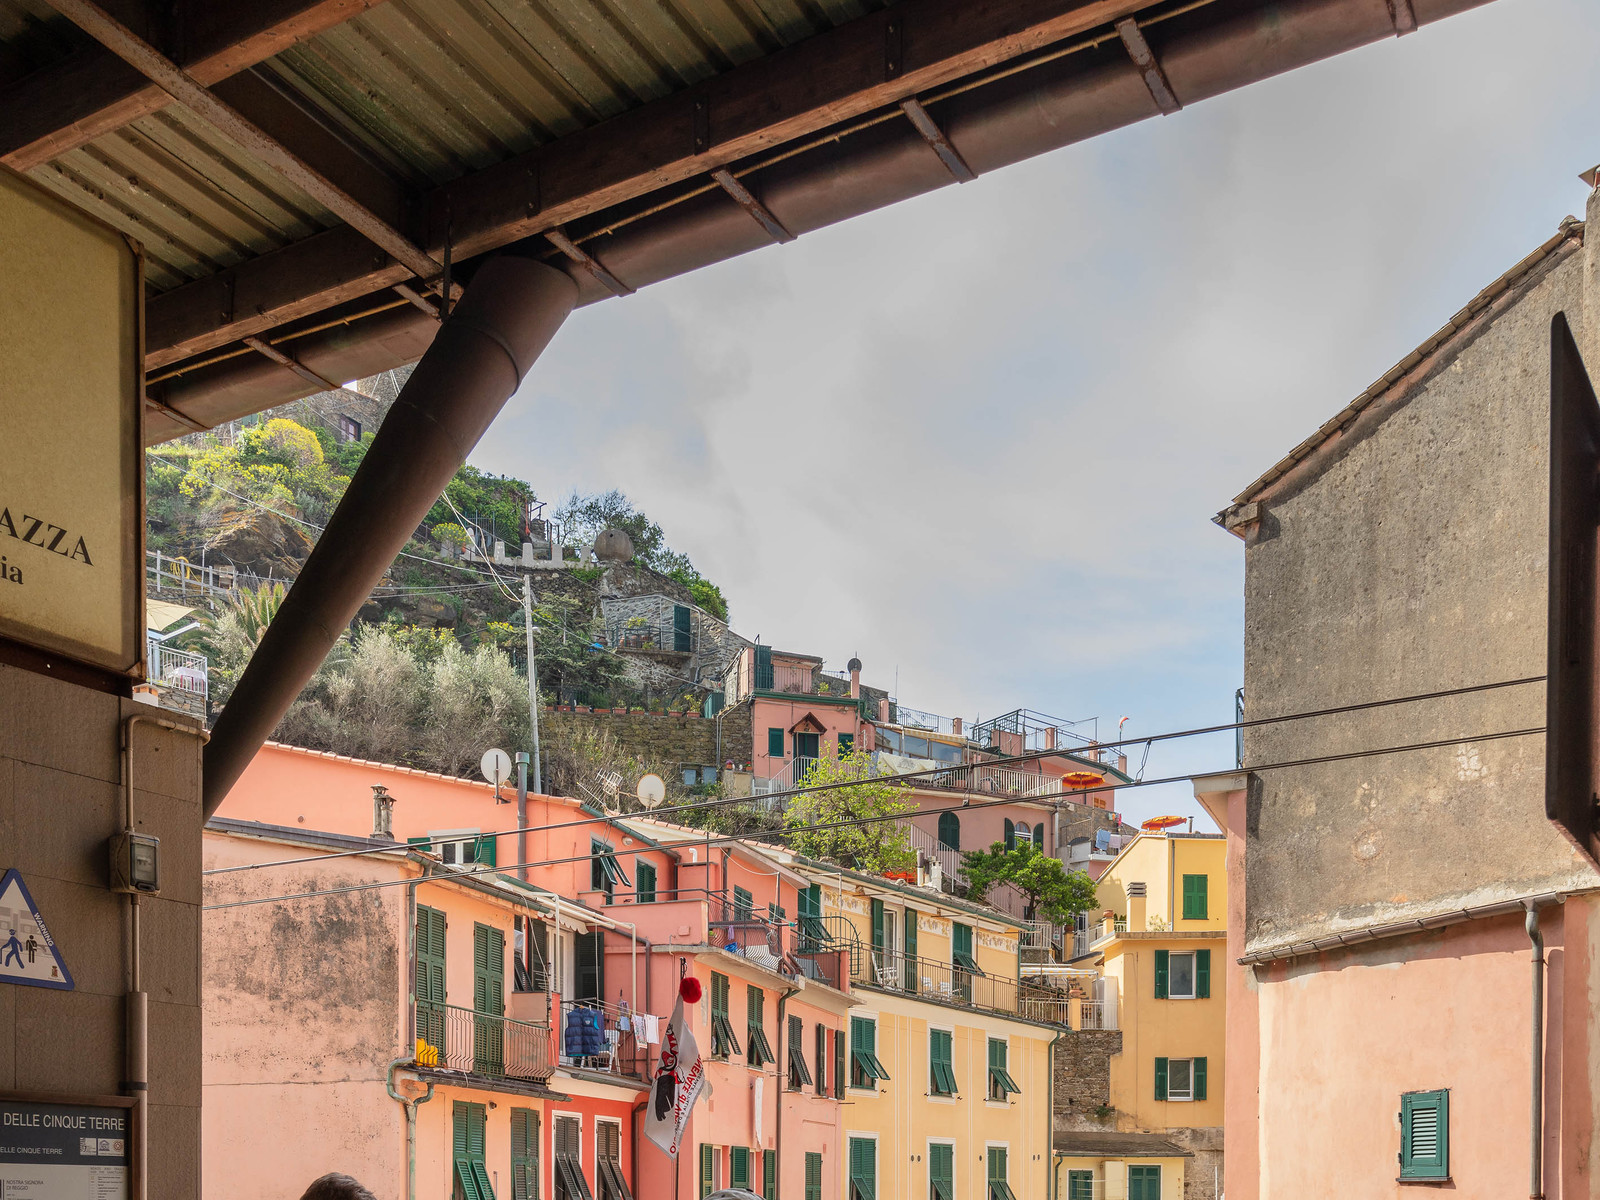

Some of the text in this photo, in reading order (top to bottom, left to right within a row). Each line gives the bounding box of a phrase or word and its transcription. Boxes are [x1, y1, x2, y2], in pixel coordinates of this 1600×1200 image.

[34, 912, 54, 947] WARNING
[3, 1112, 125, 1131] DELLE CINQUE TERRE
